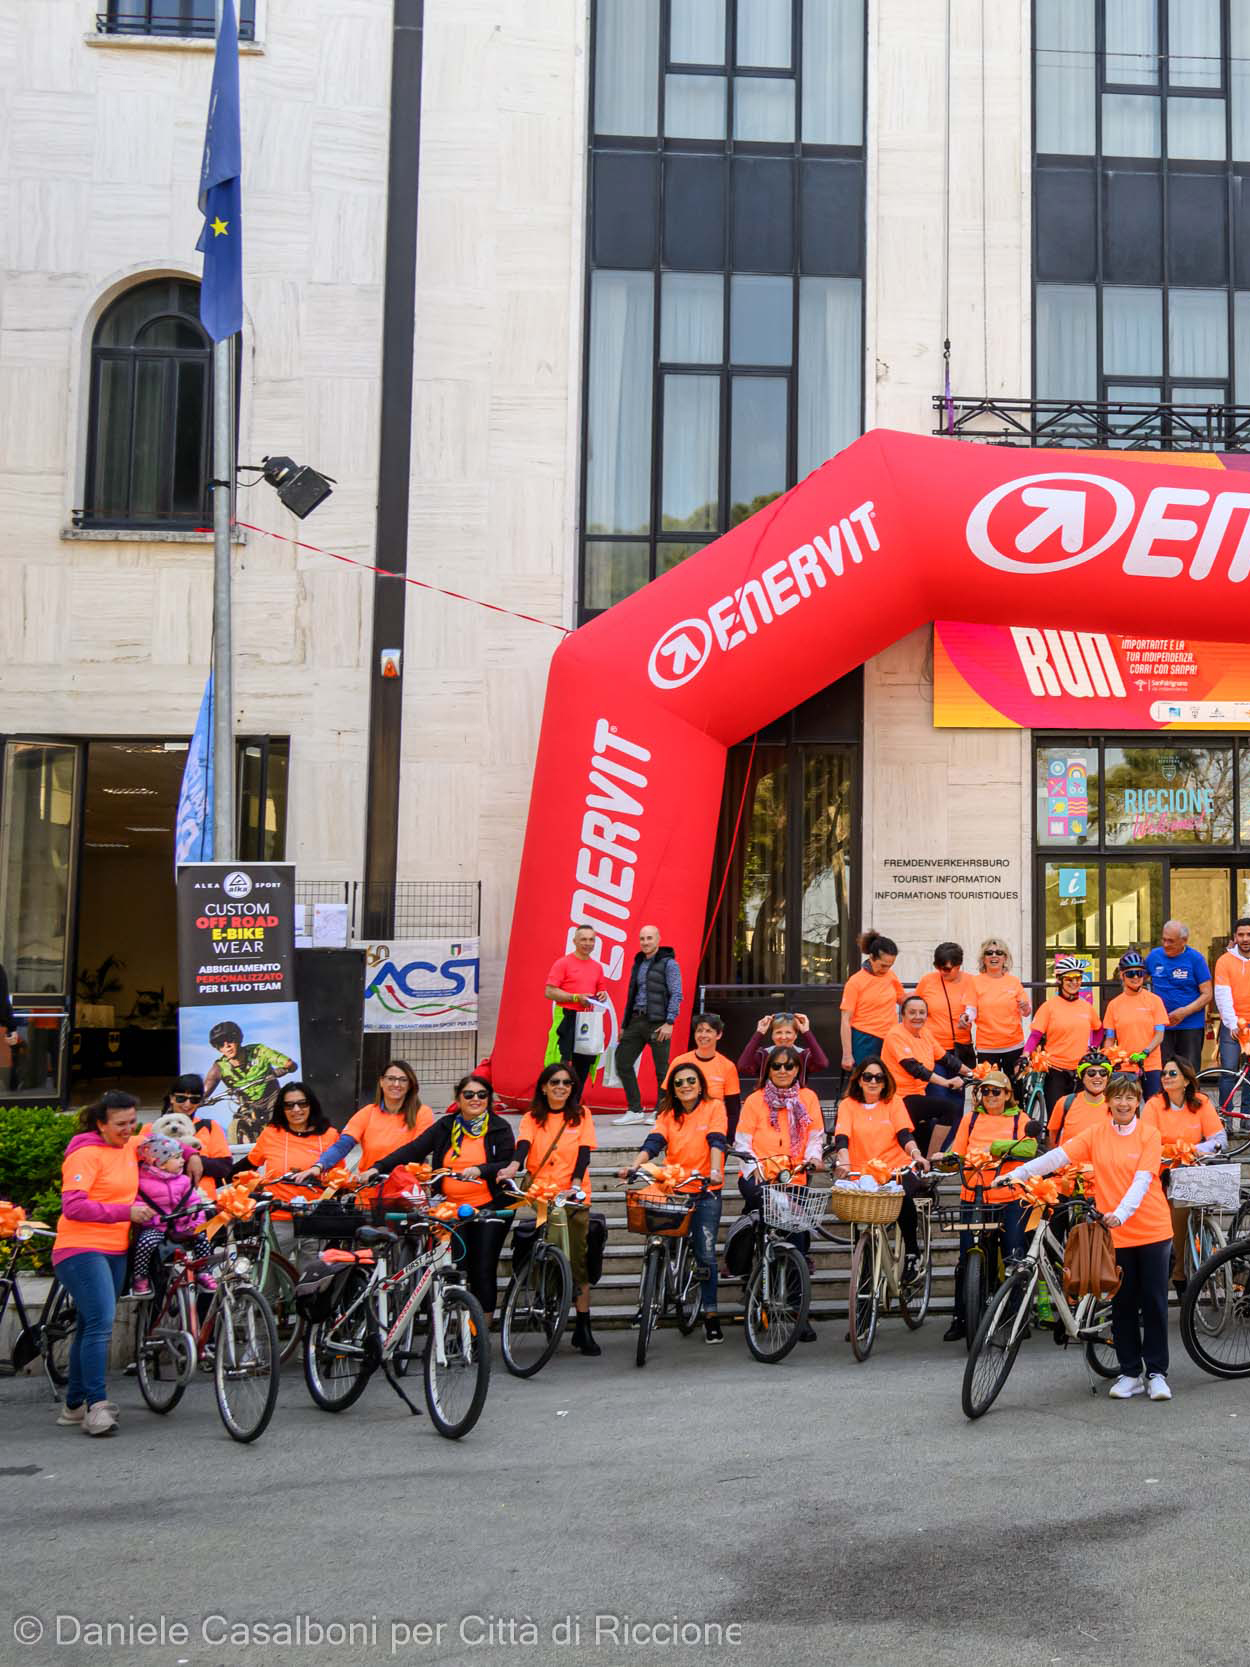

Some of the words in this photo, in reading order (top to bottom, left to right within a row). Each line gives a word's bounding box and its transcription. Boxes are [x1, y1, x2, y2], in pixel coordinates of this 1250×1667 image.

[707, 500, 881, 651] ENERVIT
[1122, 640, 1168, 650] IMPORTANTE
[1176, 640, 1185, 650] LA
[1009, 626, 1127, 698] RUN
[1126, 652, 1140, 662] TUA
[1130, 664, 1152, 674] CORRI
[1153, 664, 1169, 674] CON
[1124, 788, 1216, 814] RICCIONE
[565, 718, 652, 981] ENERVIT
[884, 859, 1010, 867] FREMDENVERKEHRSBURO
[893, 875, 934, 883] TOURIST
[936, 875, 1001, 883] INFORMATION
[875, 891, 947, 900] INFORMATIONS
[949, 891, 1019, 900] TOURISTIQUES
[205, 903, 270, 916] CUSTOM
[195, 917, 227, 929] OFF
[231, 916, 279, 928] ROAD
[212, 928, 264, 940] E-BIKE
[213, 941, 264, 954] WEAR
[199, 963, 281, 974] ABBIGLIAMENTO
[196, 973, 284, 984] PERSONALIZZATO
[365, 957, 480, 999] ACSI
[199, 984, 219, 993] PER
[220, 984, 231, 993] IL
[231, 983, 252, 992] TUO
[253, 982, 282, 991] TEAM
[405, 1258, 423, 1273] FIRST
